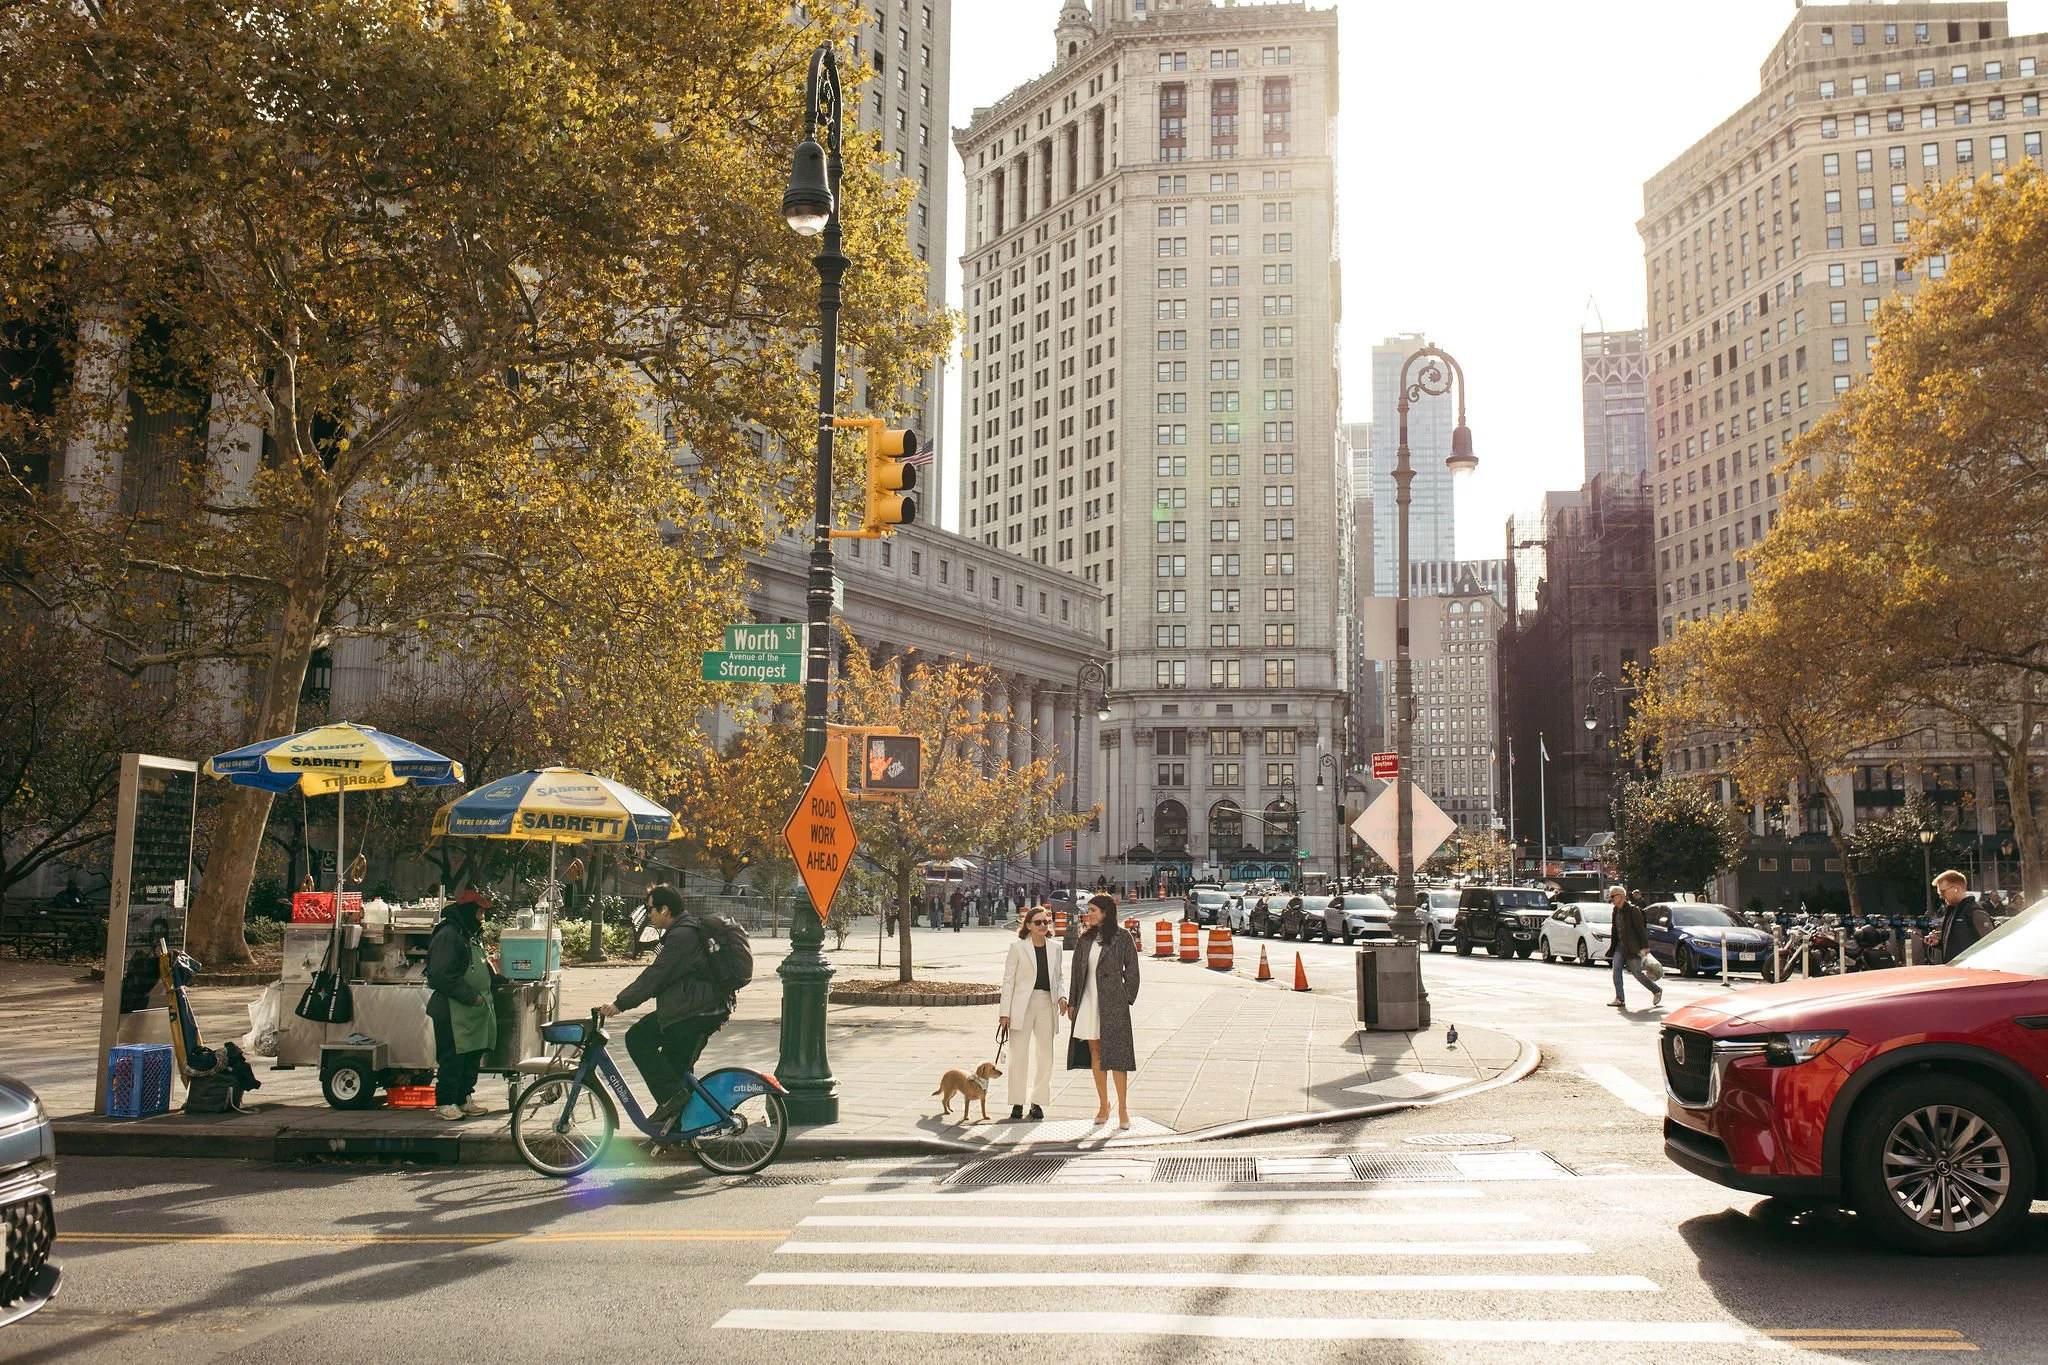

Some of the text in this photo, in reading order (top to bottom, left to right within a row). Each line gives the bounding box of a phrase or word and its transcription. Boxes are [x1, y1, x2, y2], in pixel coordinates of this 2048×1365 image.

[734, 626, 796, 651] Worth St
[728, 652, 779, 662] Avenue of the
[719, 661, 787, 682] Strongest
[290, 743, 365, 753] SABRETT
[291, 756, 363, 769] SABRETT
[537, 786, 600, 797] SABRETT
[811, 797, 837, 819] ROAD
[522, 811, 623, 835] SABRETT
[810, 823, 836, 845] WORK
[806, 850, 838, 872] AHEAD
